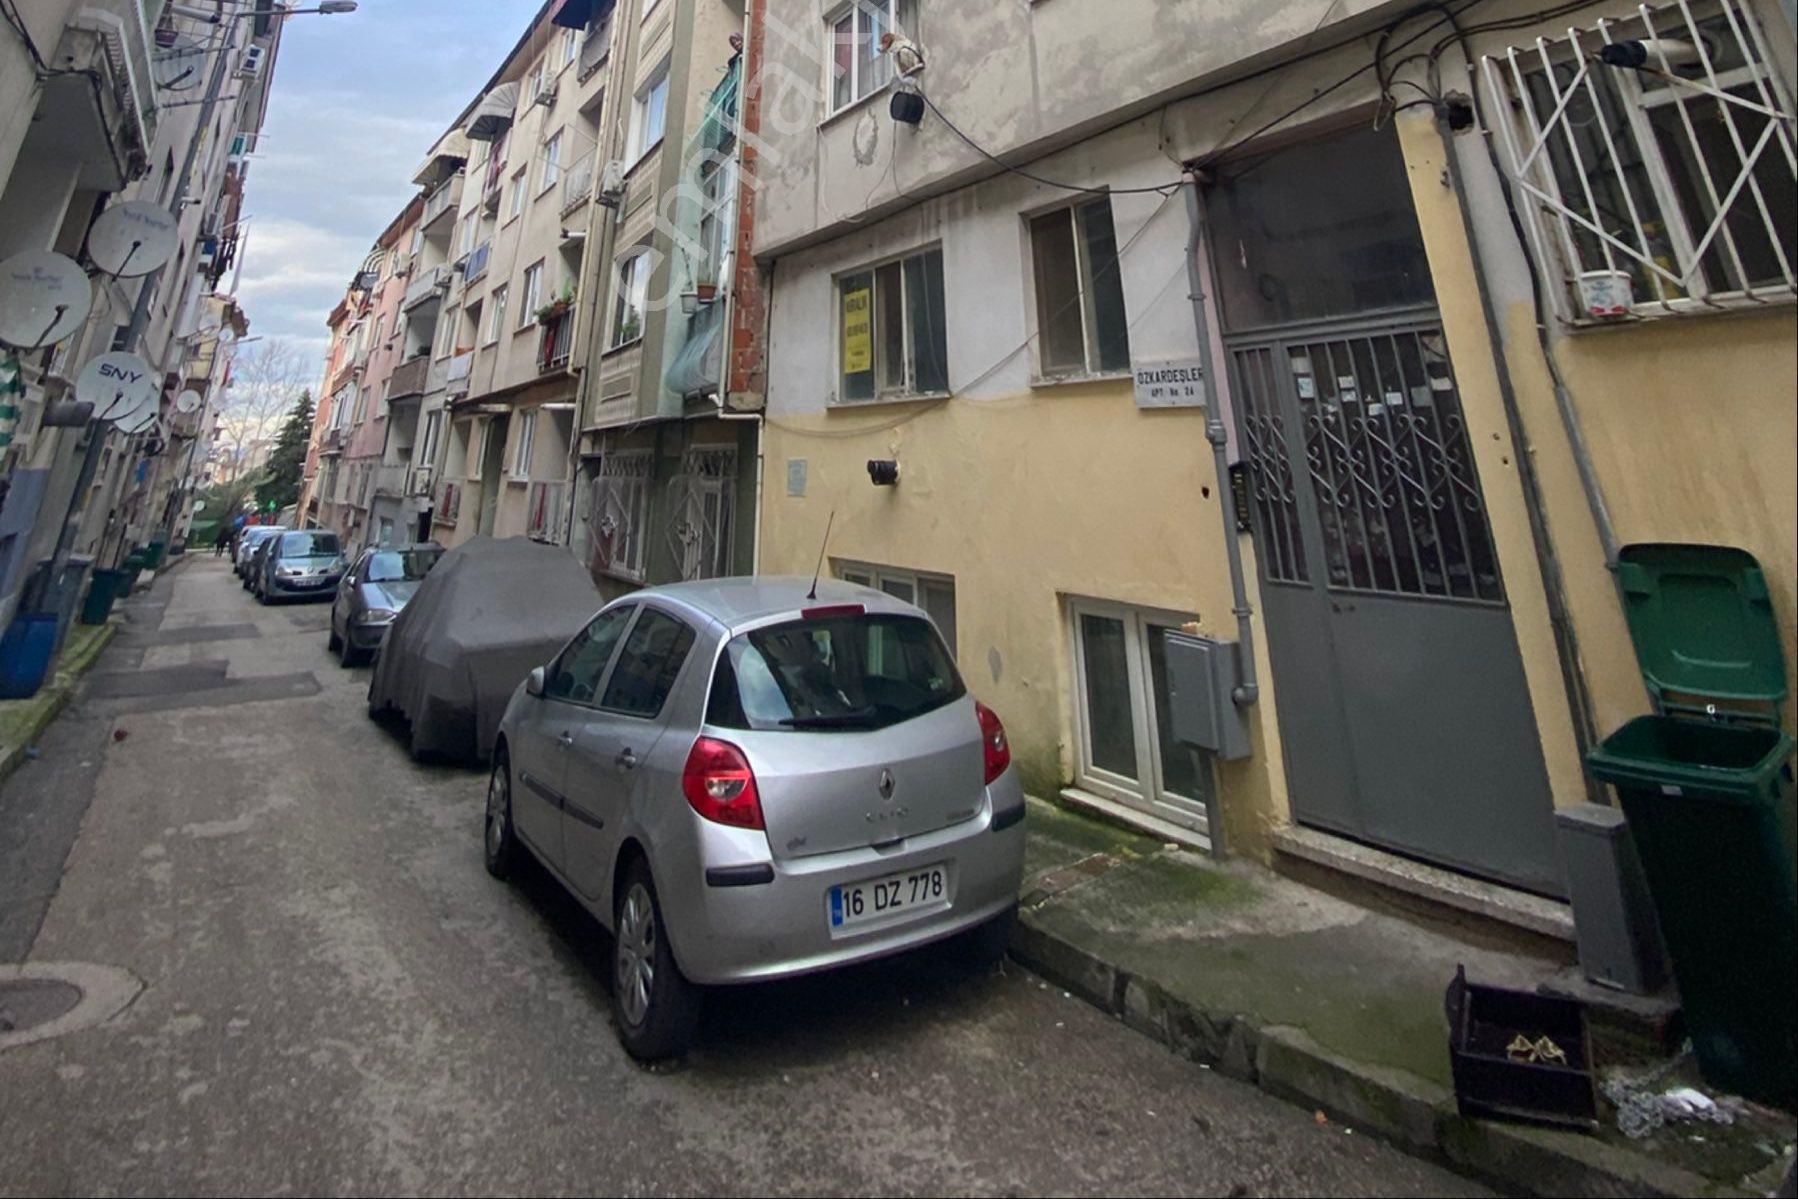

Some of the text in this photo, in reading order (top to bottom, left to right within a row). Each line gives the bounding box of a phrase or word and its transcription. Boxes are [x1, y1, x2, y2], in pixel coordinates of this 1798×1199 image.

[98, 363, 143, 384] SNY
[843, 870, 942, 917] 16 DZ 778
